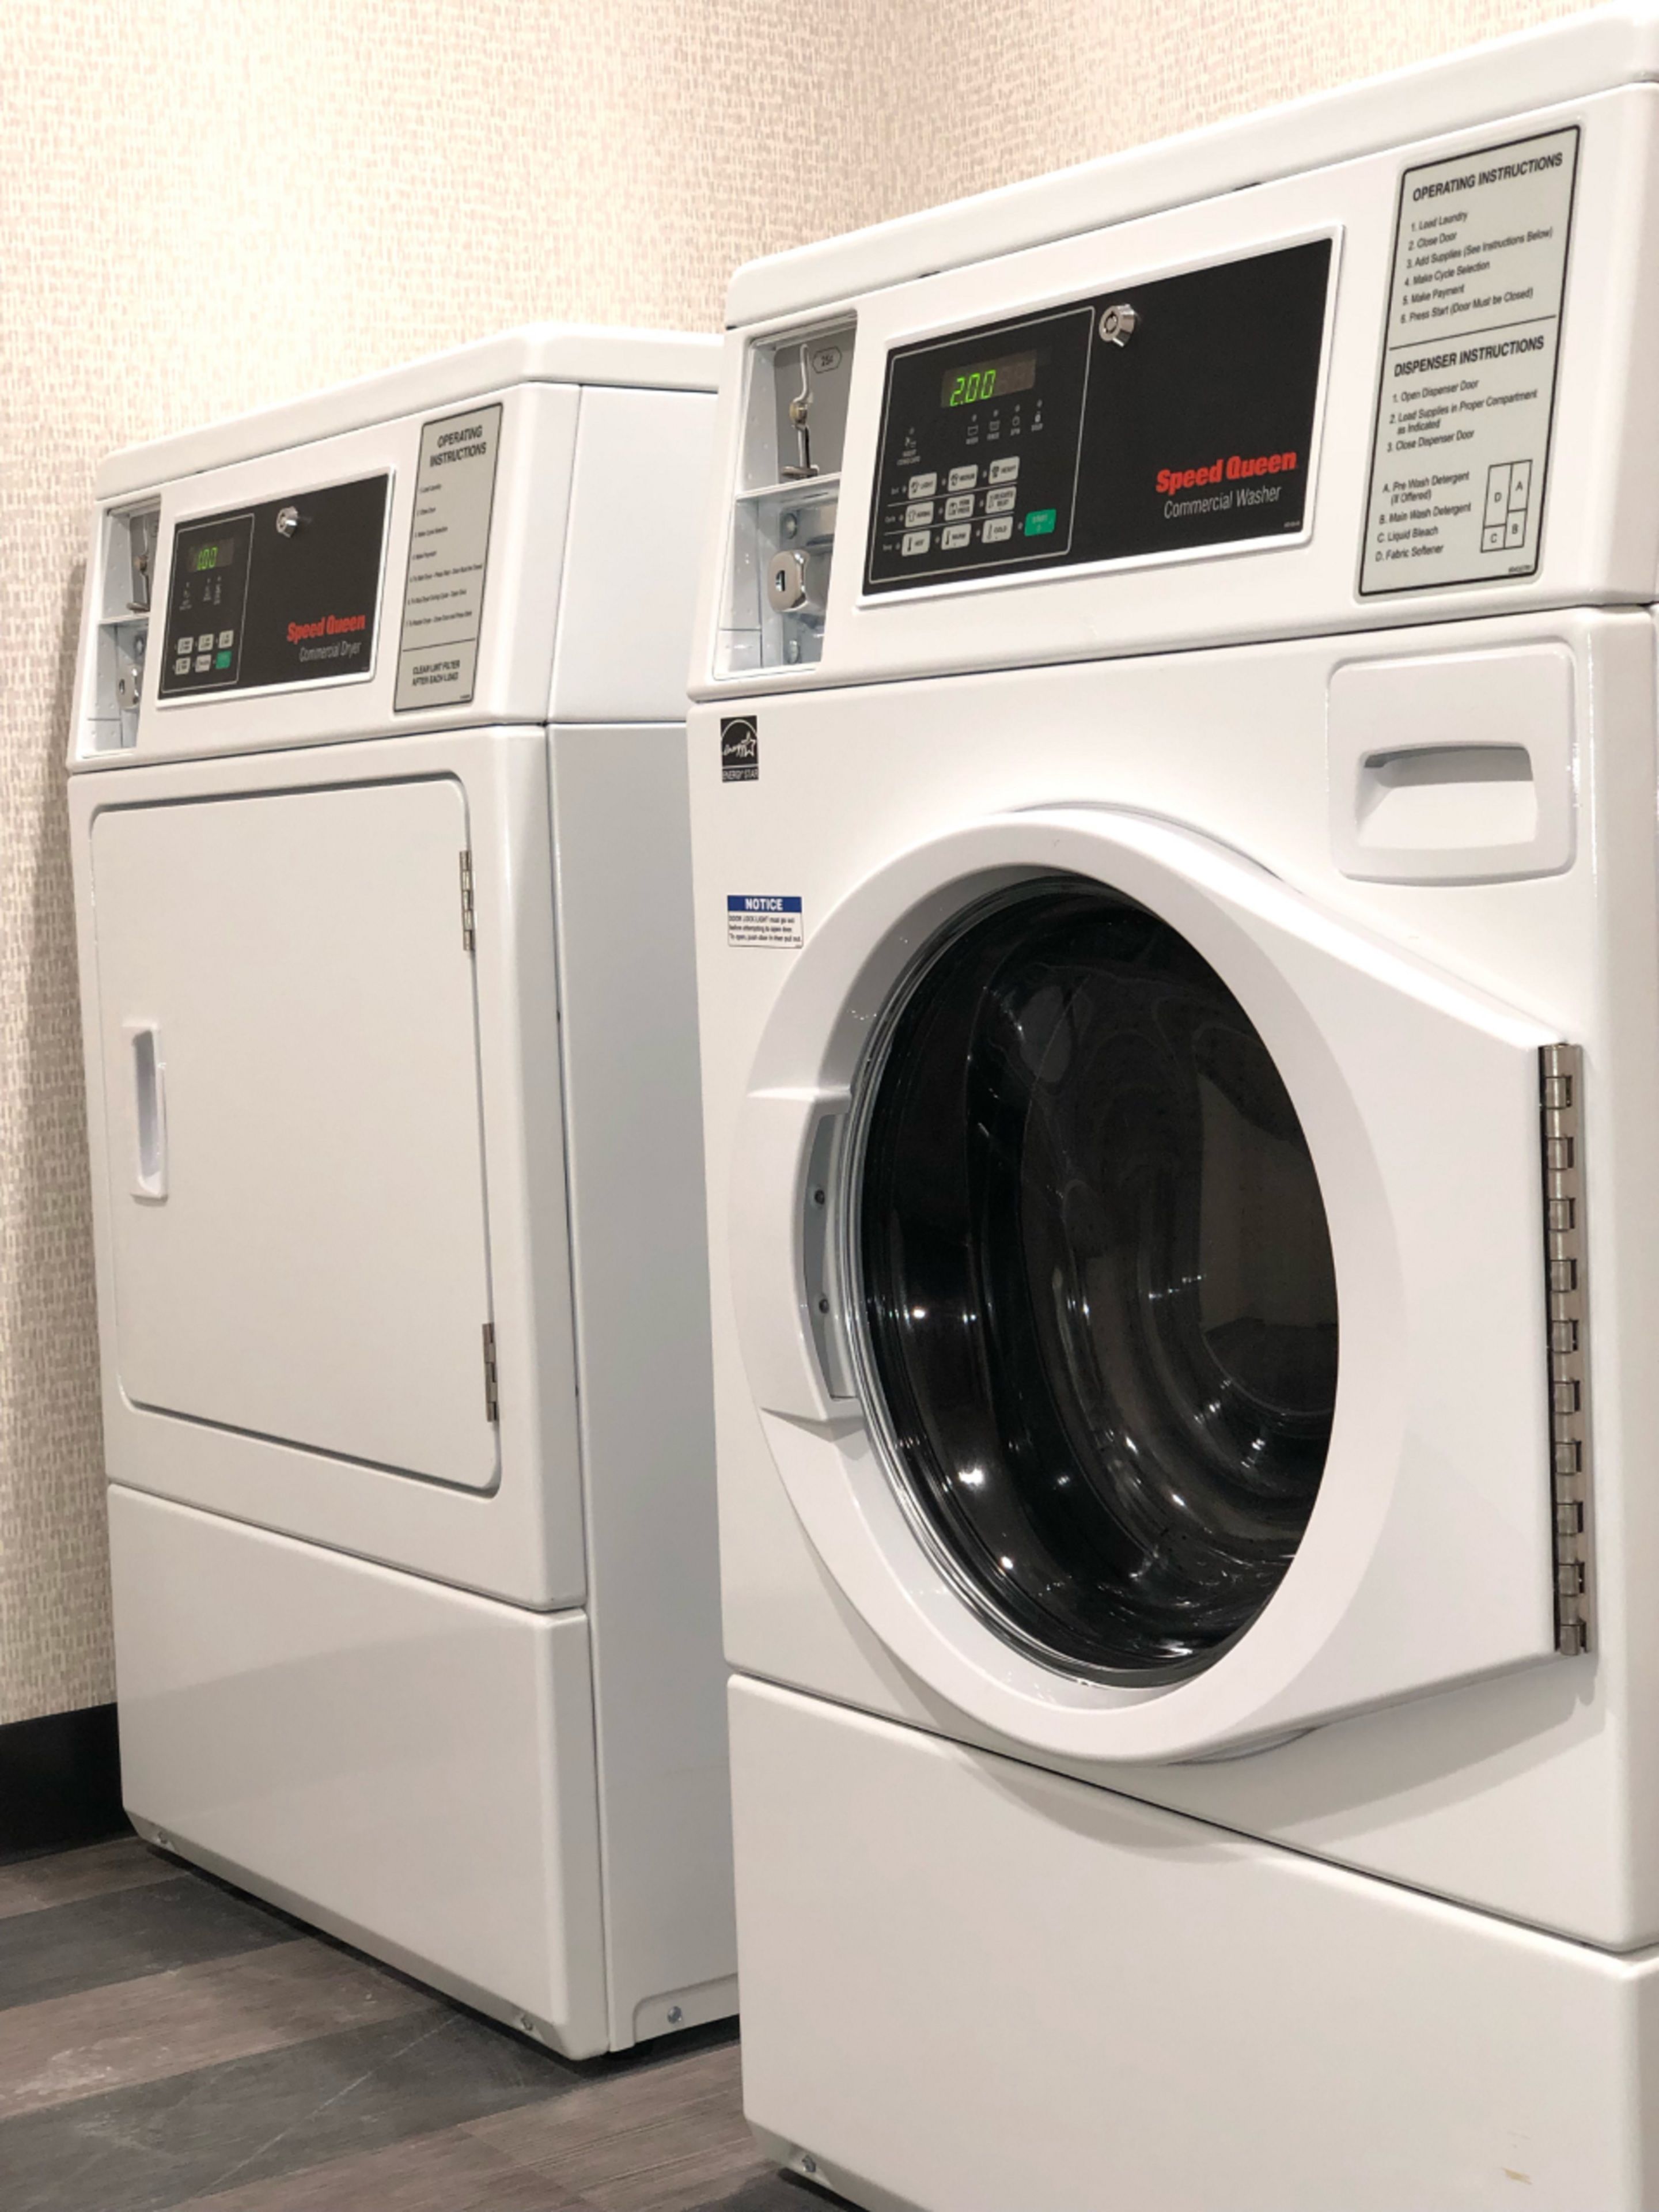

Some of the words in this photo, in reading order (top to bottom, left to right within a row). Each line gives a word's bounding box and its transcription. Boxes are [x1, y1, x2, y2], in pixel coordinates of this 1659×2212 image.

[1413, 174, 1475, 201] OPERATING
[1478, 152, 1563, 185] INSTRUCTIONS
[1419, 218, 1437, 230] Load
[1439, 211, 1468, 225] Laundry
[1415, 255, 1429, 266] Add
[1431, 249, 1461, 263] Supplies
[1464, 245, 1480, 257] (See
[1483, 235, 1525, 251] Instructions
[1527, 226, 1553, 242] Below)
[1417, 237, 1438, 248] Close
[1440, 232, 1457, 243] Door
[1414, 274, 1433, 285] Make
[1434, 269, 1455, 281] Cycle
[1457, 262, 1490, 275] Selection
[1411, 292, 1431, 302] Make
[1433, 283, 1464, 299] Payment
[1409, 311, 1430, 321] Press
[1431, 305, 1449, 317] Start
[1450, 302, 1471, 316] (Door
[1472, 296, 1491, 308] Must
[1493, 295, 1502, 305] be
[1503, 287, 1533, 302] Closed)
[1394, 352, 1456, 377] DISPENSER
[1460, 335, 1544, 364] INSTRUCTIONS
[950, 369, 996, 407] 2.00
[1401, 391, 1421, 402] Open
[1422, 384, 1459, 397] Dispenser
[1460, 380, 1479, 391] Door
[1398, 410, 1417, 422] Load
[1419, 406, 1449, 418] Supplies
[1451, 404, 1457, 413] in
[1459, 400, 1484, 411] Proper
[1486, 388, 1537, 407] Compartment
[437, 425, 482, 448] OPERATING
[1397, 427, 1405, 435] as
[1408, 419, 1441, 433] Indicated
[1396, 440, 1416, 450] Close
[1418, 433, 1455, 447] Dispenser
[1456, 430, 1475, 441] Door
[430, 442, 487, 467] INSTRUCTIONS
[1156, 459, 1224, 496] Speed
[1226, 451, 1297, 479] Queen
[1393, 482, 1406, 491] Pre
[1408, 478, 1429, 488] Wash
[1431, 471, 1469, 486] Detergent
[1401, 489, 1432, 503] Offered)
[1516, 481, 1522, 491] A
[1164, 491, 1233, 519] Commercial
[1236, 485, 1282, 507] Washer
[1494, 492, 1502, 503] D
[1389, 512, 1407, 522] Main
[1410, 509, 1431, 519] Wash
[1433, 502, 1471, 517] Detergent
[1388, 529, 1410, 542] Liquid
[1412, 525, 1438, 538] Bleach
[1490, 533, 1497, 543] C
[1512, 524, 1518, 535] B
[1386, 549, 1409, 560] Fabric
[1411, 545, 1444, 556] Softener
[287, 616, 325, 645] Speed
[327, 614, 366, 635] Queen
[299, 642, 340, 662] Commercial
[340, 641, 362, 658] Dryer
[722, 770, 743, 781] ENERGY
[745, 899, 783, 910] NOTICE
